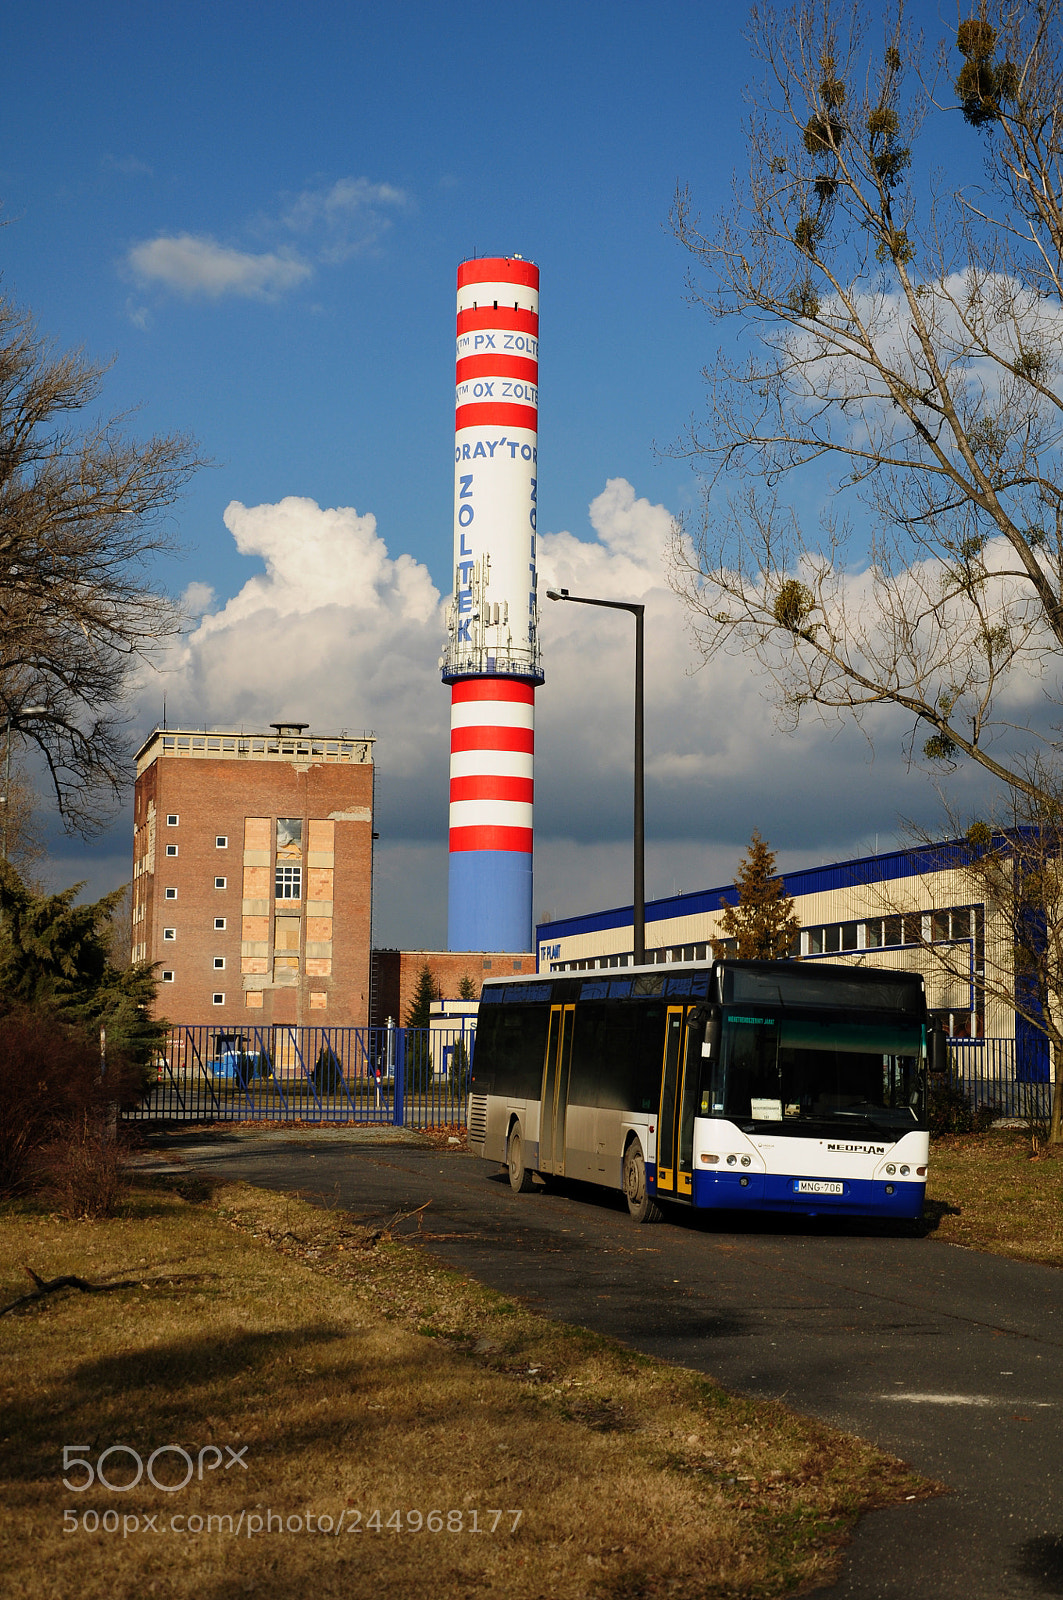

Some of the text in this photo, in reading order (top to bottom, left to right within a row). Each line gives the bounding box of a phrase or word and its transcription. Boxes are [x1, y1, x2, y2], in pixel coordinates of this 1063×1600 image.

[474, 334, 496, 349] PX
[473, 382, 495, 397] OX
[458, 474, 474, 643] ZOLTEK
[827, 1143, 885, 1155] NEOPLAN
[800, 1182, 841, 1193] MNG-706
